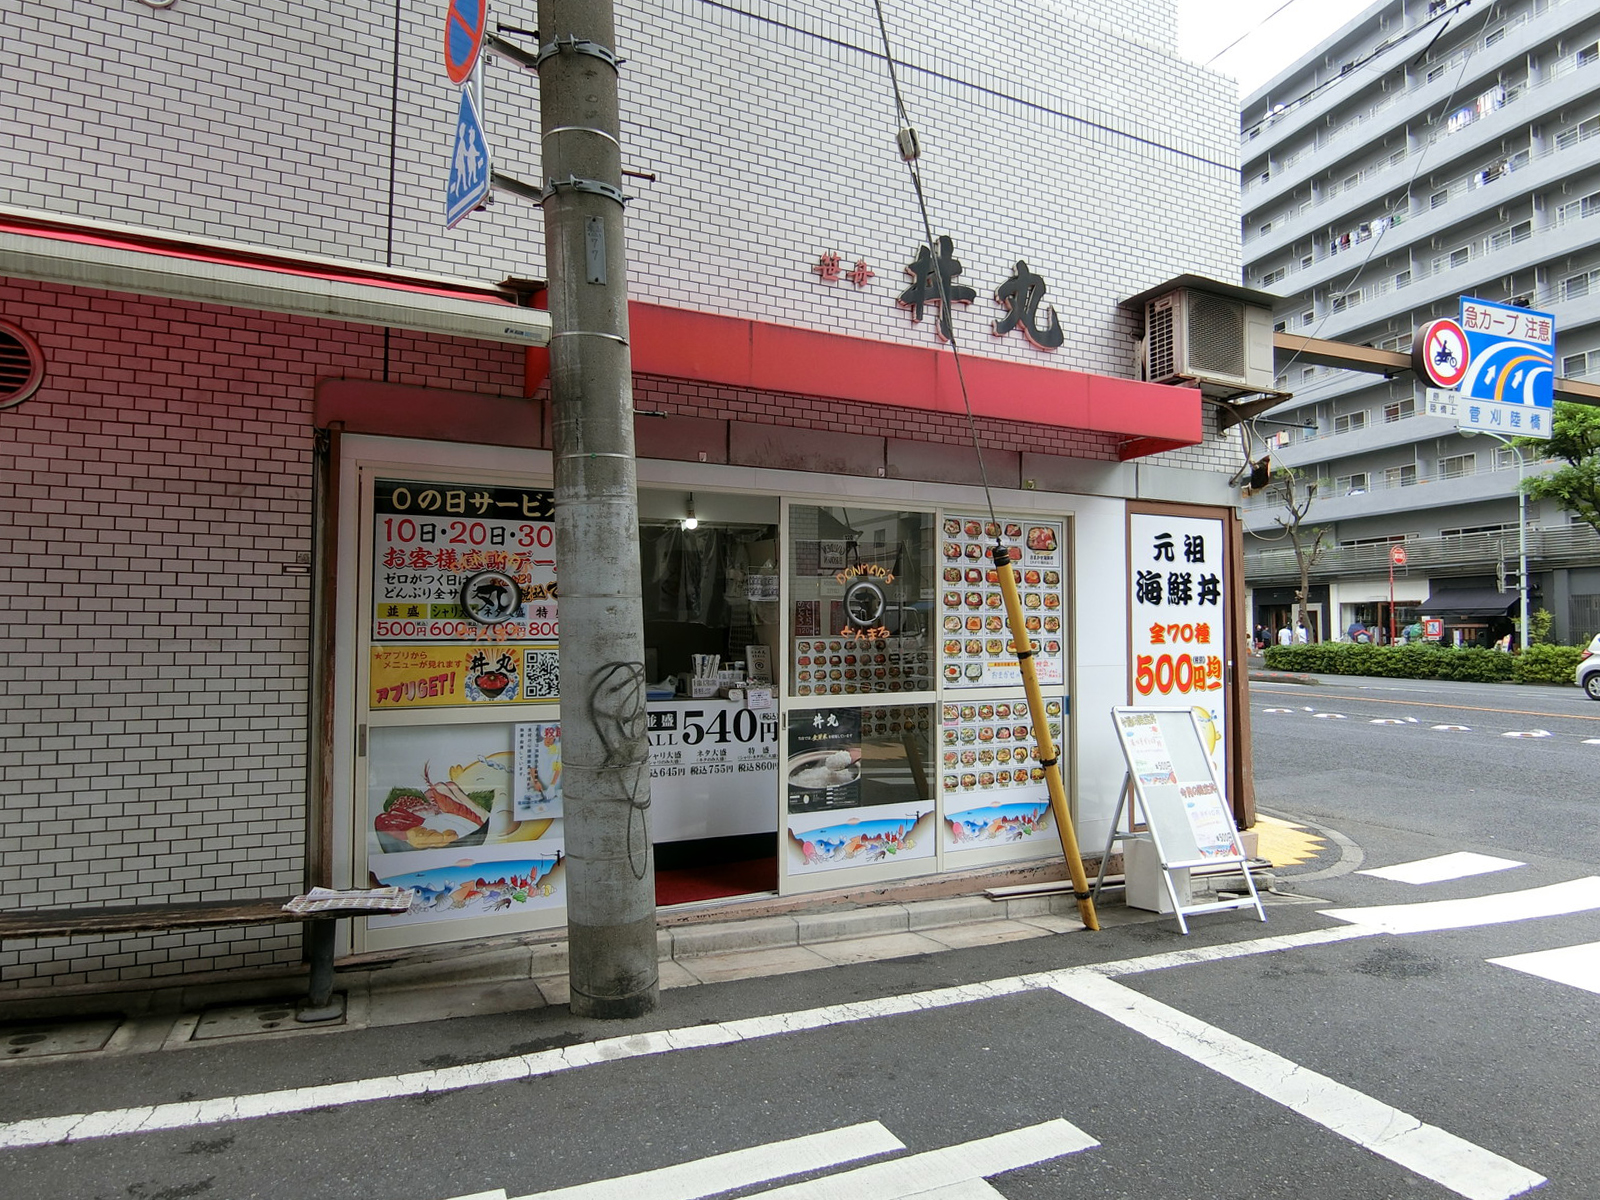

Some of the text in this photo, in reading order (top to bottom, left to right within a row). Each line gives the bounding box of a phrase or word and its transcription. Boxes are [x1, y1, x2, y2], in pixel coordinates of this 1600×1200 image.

[1153, 532, 1205, 563] 元祖
[1136, 570, 1221, 606] 海鮮丼
[536, 606, 558, 619] 特
[1149, 622, 1211, 645] 全70種
